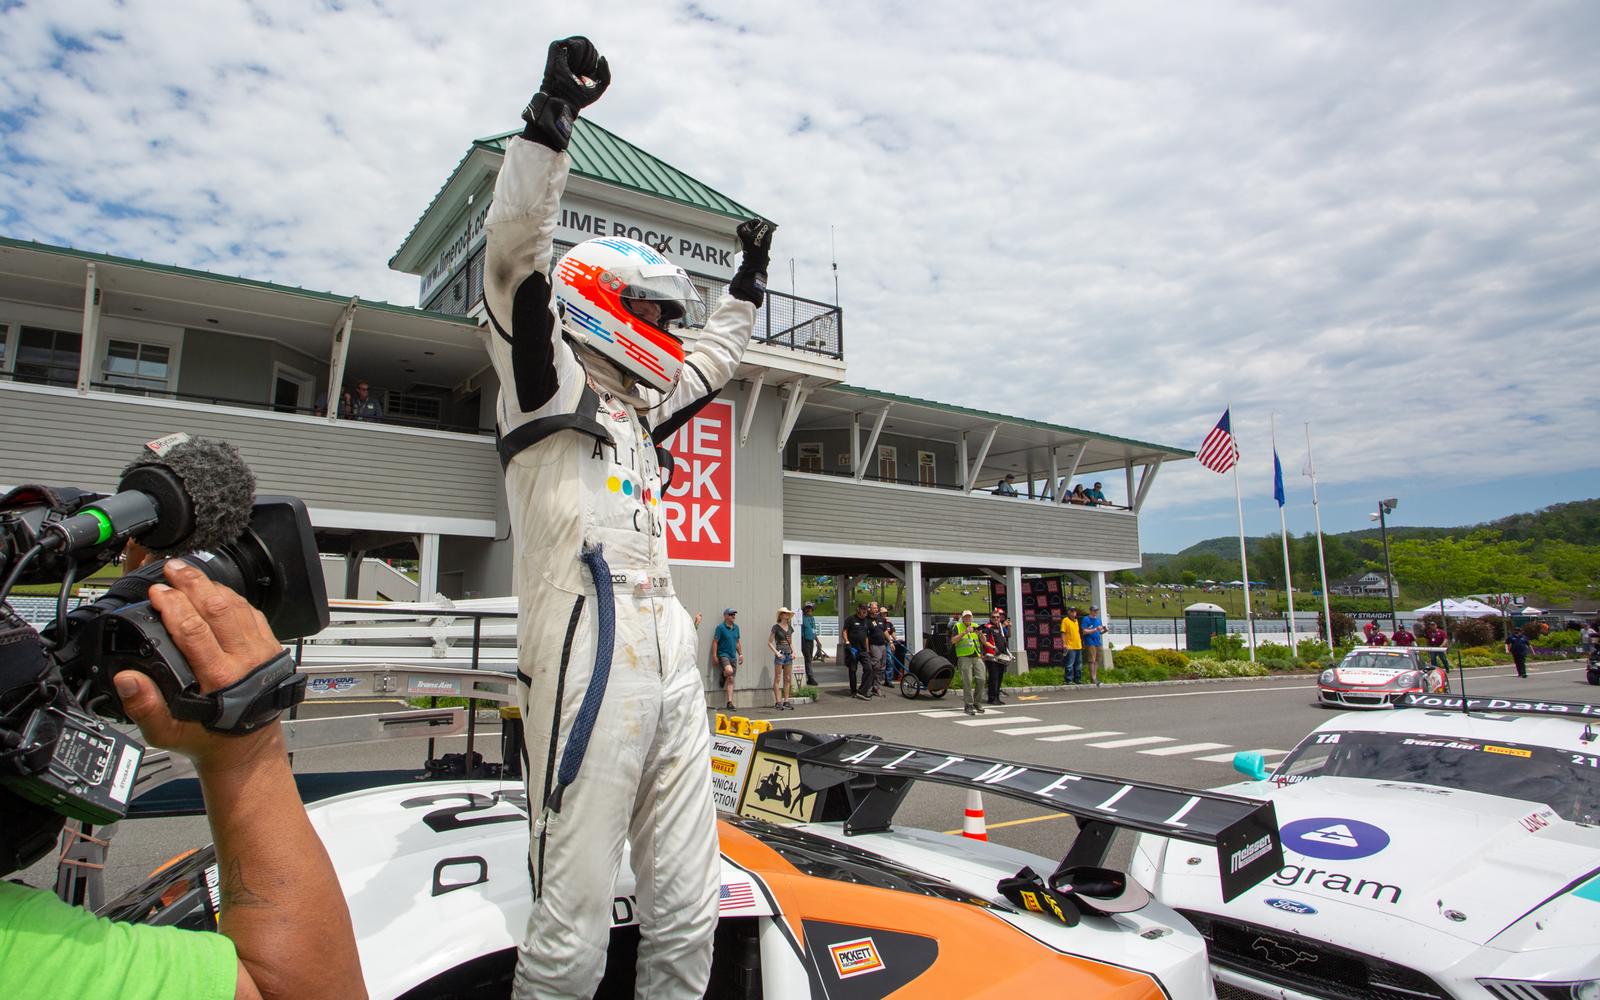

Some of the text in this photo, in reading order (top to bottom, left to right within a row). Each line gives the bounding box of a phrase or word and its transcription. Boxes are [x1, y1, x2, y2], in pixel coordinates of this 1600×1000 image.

[557, 209, 732, 268] IME ROCK PARK
[662, 502, 721, 544] RK
[1358, 612, 1393, 620] STRAIGHT
[1407, 694, 1481, 708] Your
[1487, 698, 1569, 713] Data
[1316, 734, 1341, 744] TA
[713, 741, 743, 756] Trans Am
[712, 776, 738, 794] HNICAL
[840, 744, 1201, 828] ALTWELL
[712, 791, 737, 808] CTION
[1273, 899, 1308, 913] Ford
[839, 946, 873, 964] PICKETT
